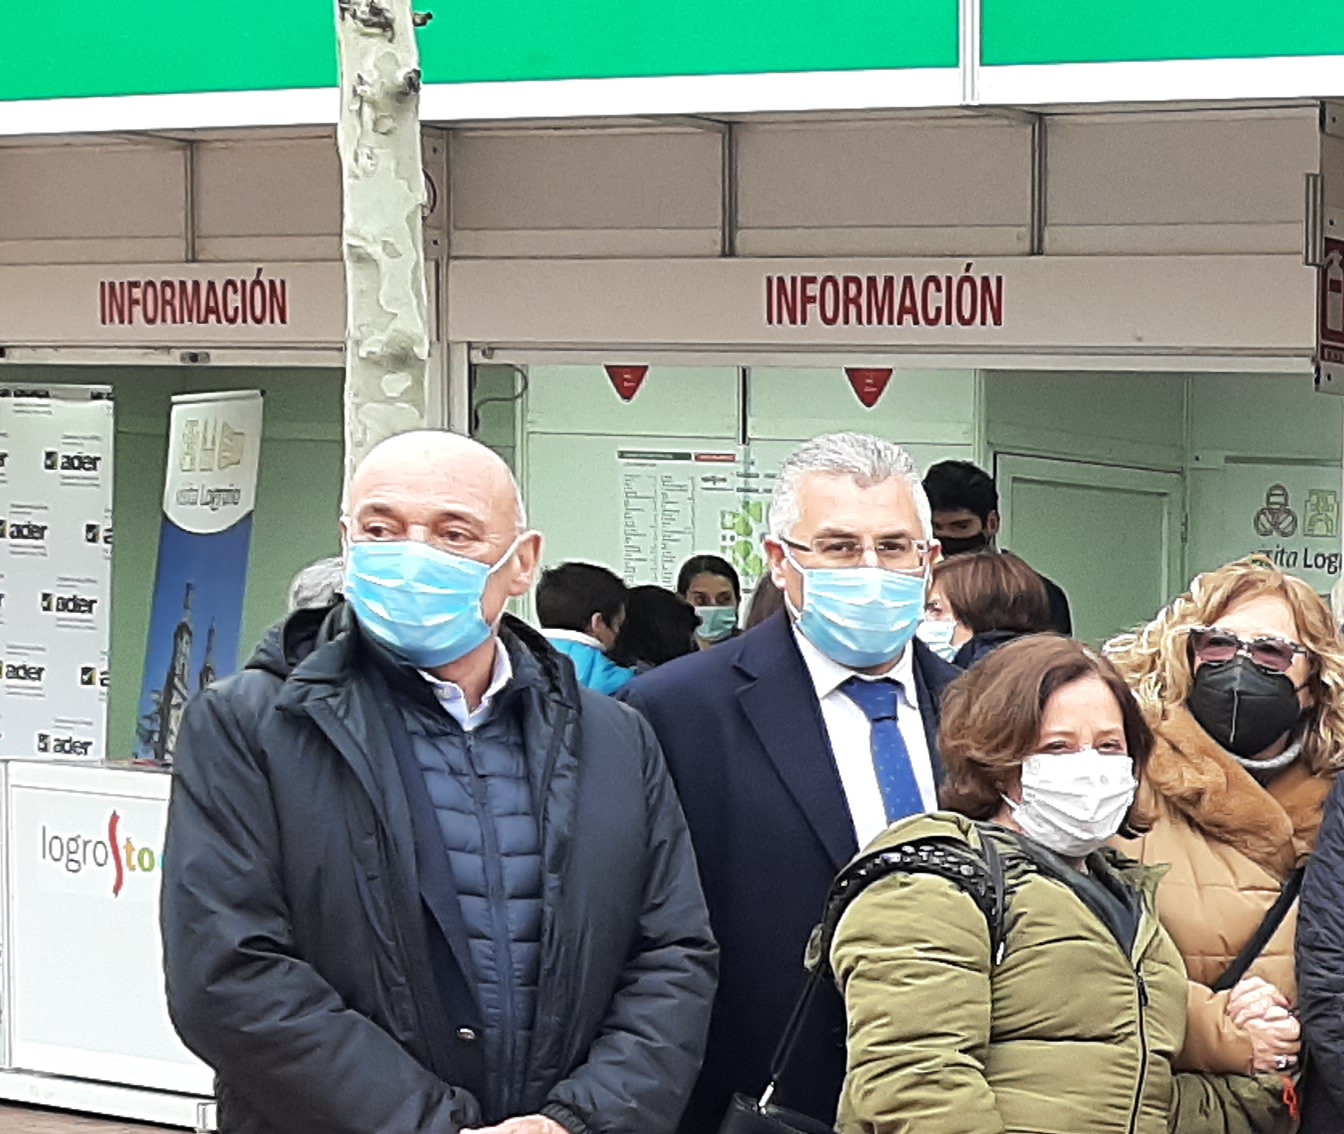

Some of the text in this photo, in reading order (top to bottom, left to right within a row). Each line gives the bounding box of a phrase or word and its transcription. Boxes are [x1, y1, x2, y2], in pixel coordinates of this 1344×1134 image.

[100, 267, 288, 325] INFORMACIÓN
[765, 262, 1003, 326] INFORMACIÓN
[9, 521, 49, 540] ader
[5, 661, 45, 681] ader
[52, 734, 93, 755] ader
